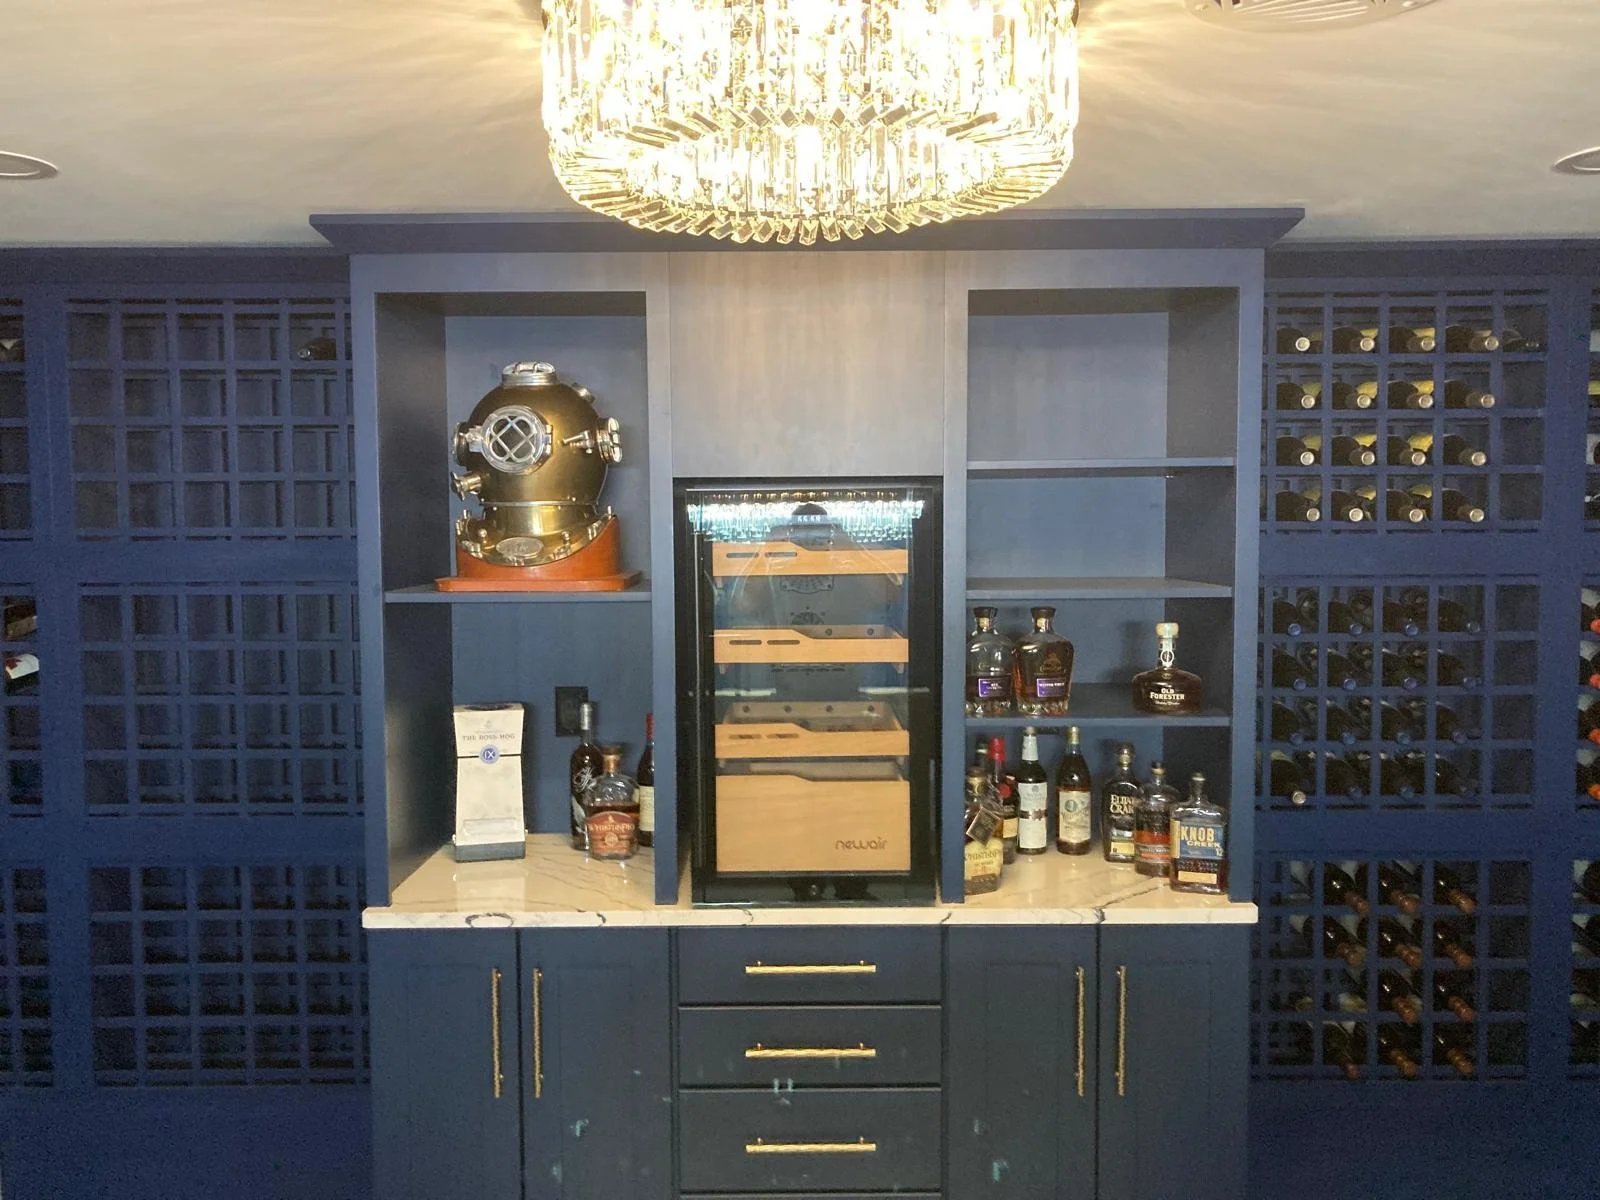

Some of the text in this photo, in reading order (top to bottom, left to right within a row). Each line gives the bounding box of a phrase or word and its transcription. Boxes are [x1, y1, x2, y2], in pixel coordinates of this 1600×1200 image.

[1181, 826, 1214, 842] KNOB
[835, 836, 888, 850] newair
[1216, 848, 1224, 856] 12
